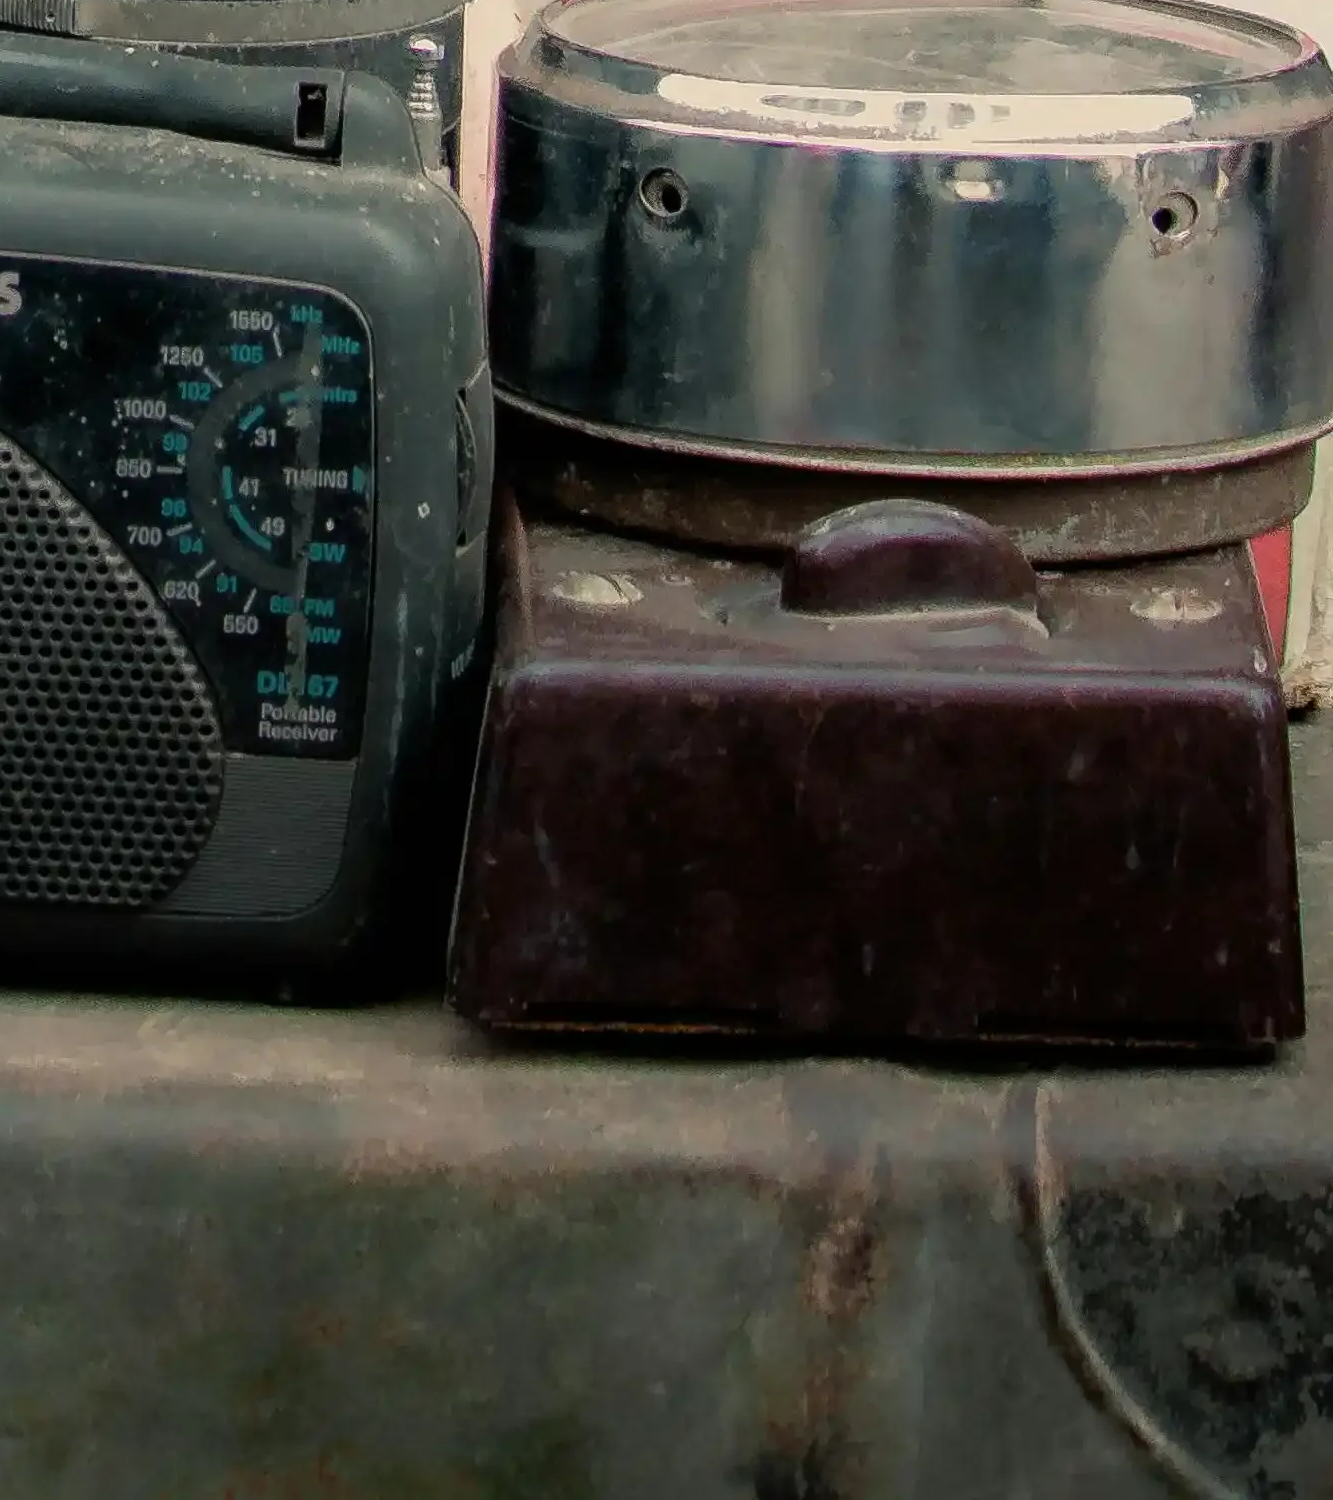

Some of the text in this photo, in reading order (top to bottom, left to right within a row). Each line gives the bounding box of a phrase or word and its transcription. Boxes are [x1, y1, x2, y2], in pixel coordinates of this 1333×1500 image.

[290, 305, 324, 325] kHz
[177, 380, 212, 402] 102
[122, 400, 168, 420] 1000
[253, 427, 278, 449] 31
[238, 476, 262, 497] 41
[126, 525, 163, 546] 700
[260, 515, 286, 537] 49
[257, 719, 338, 743] Receiver
